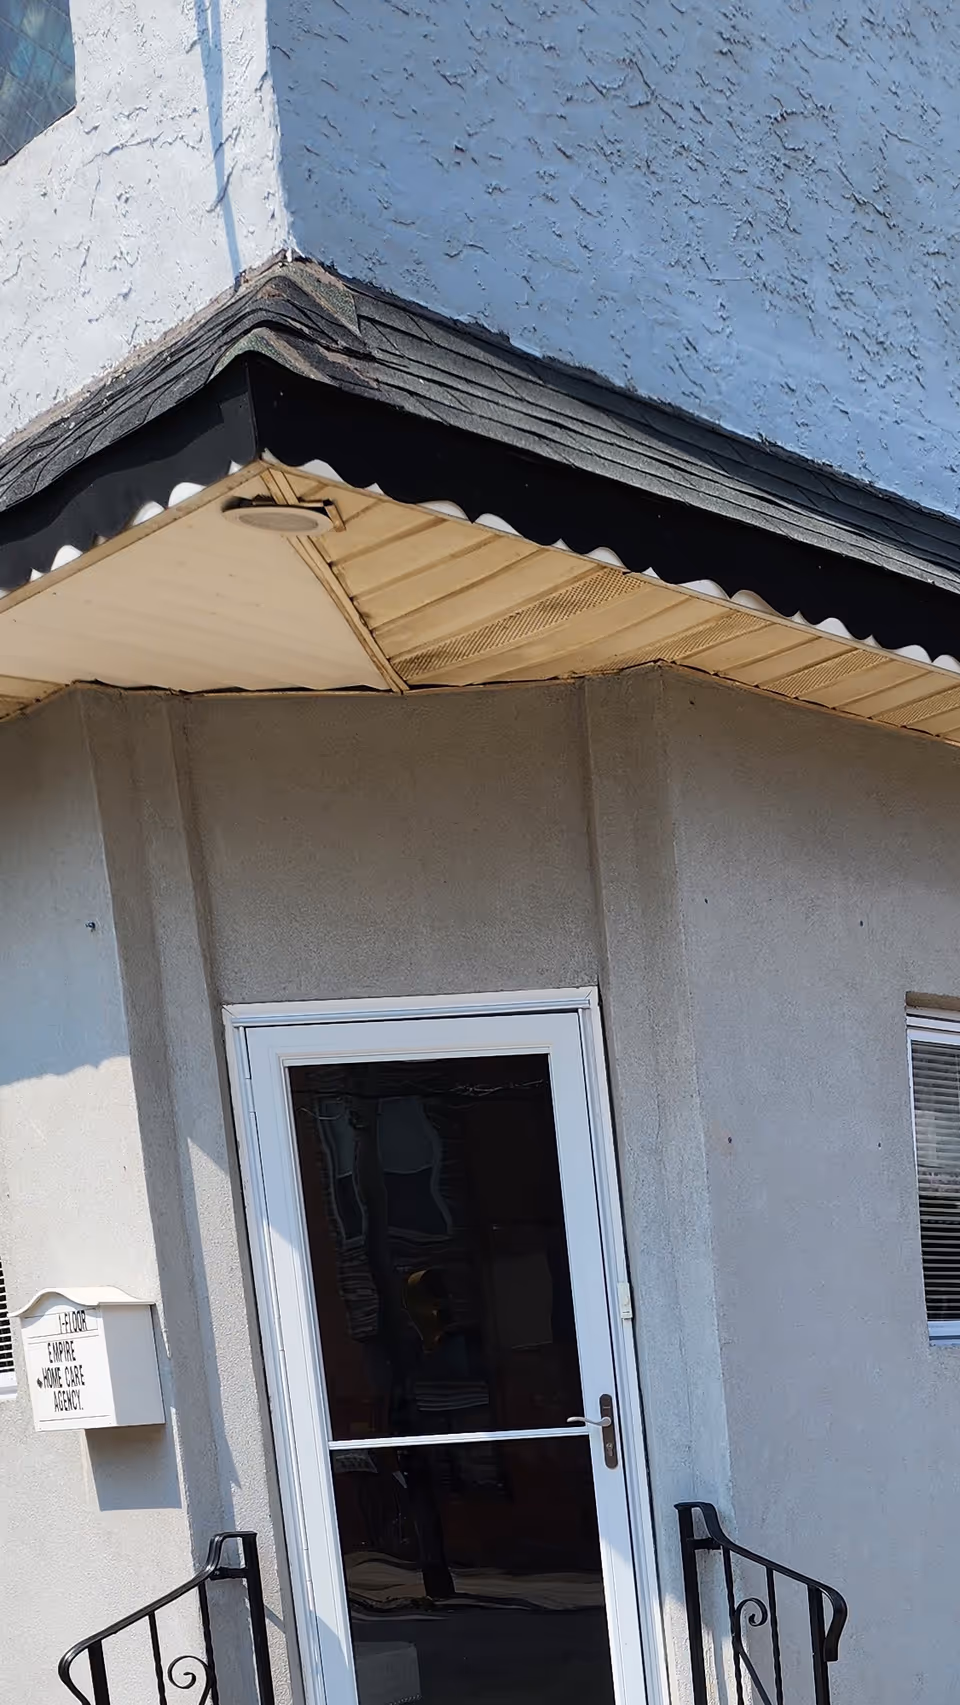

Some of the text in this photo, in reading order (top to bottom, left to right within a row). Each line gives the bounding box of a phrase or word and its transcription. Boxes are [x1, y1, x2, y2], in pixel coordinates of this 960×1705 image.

[48, 1341, 76, 1363] EMPIRE
[42, 1365, 85, 1389] HOME CARE
